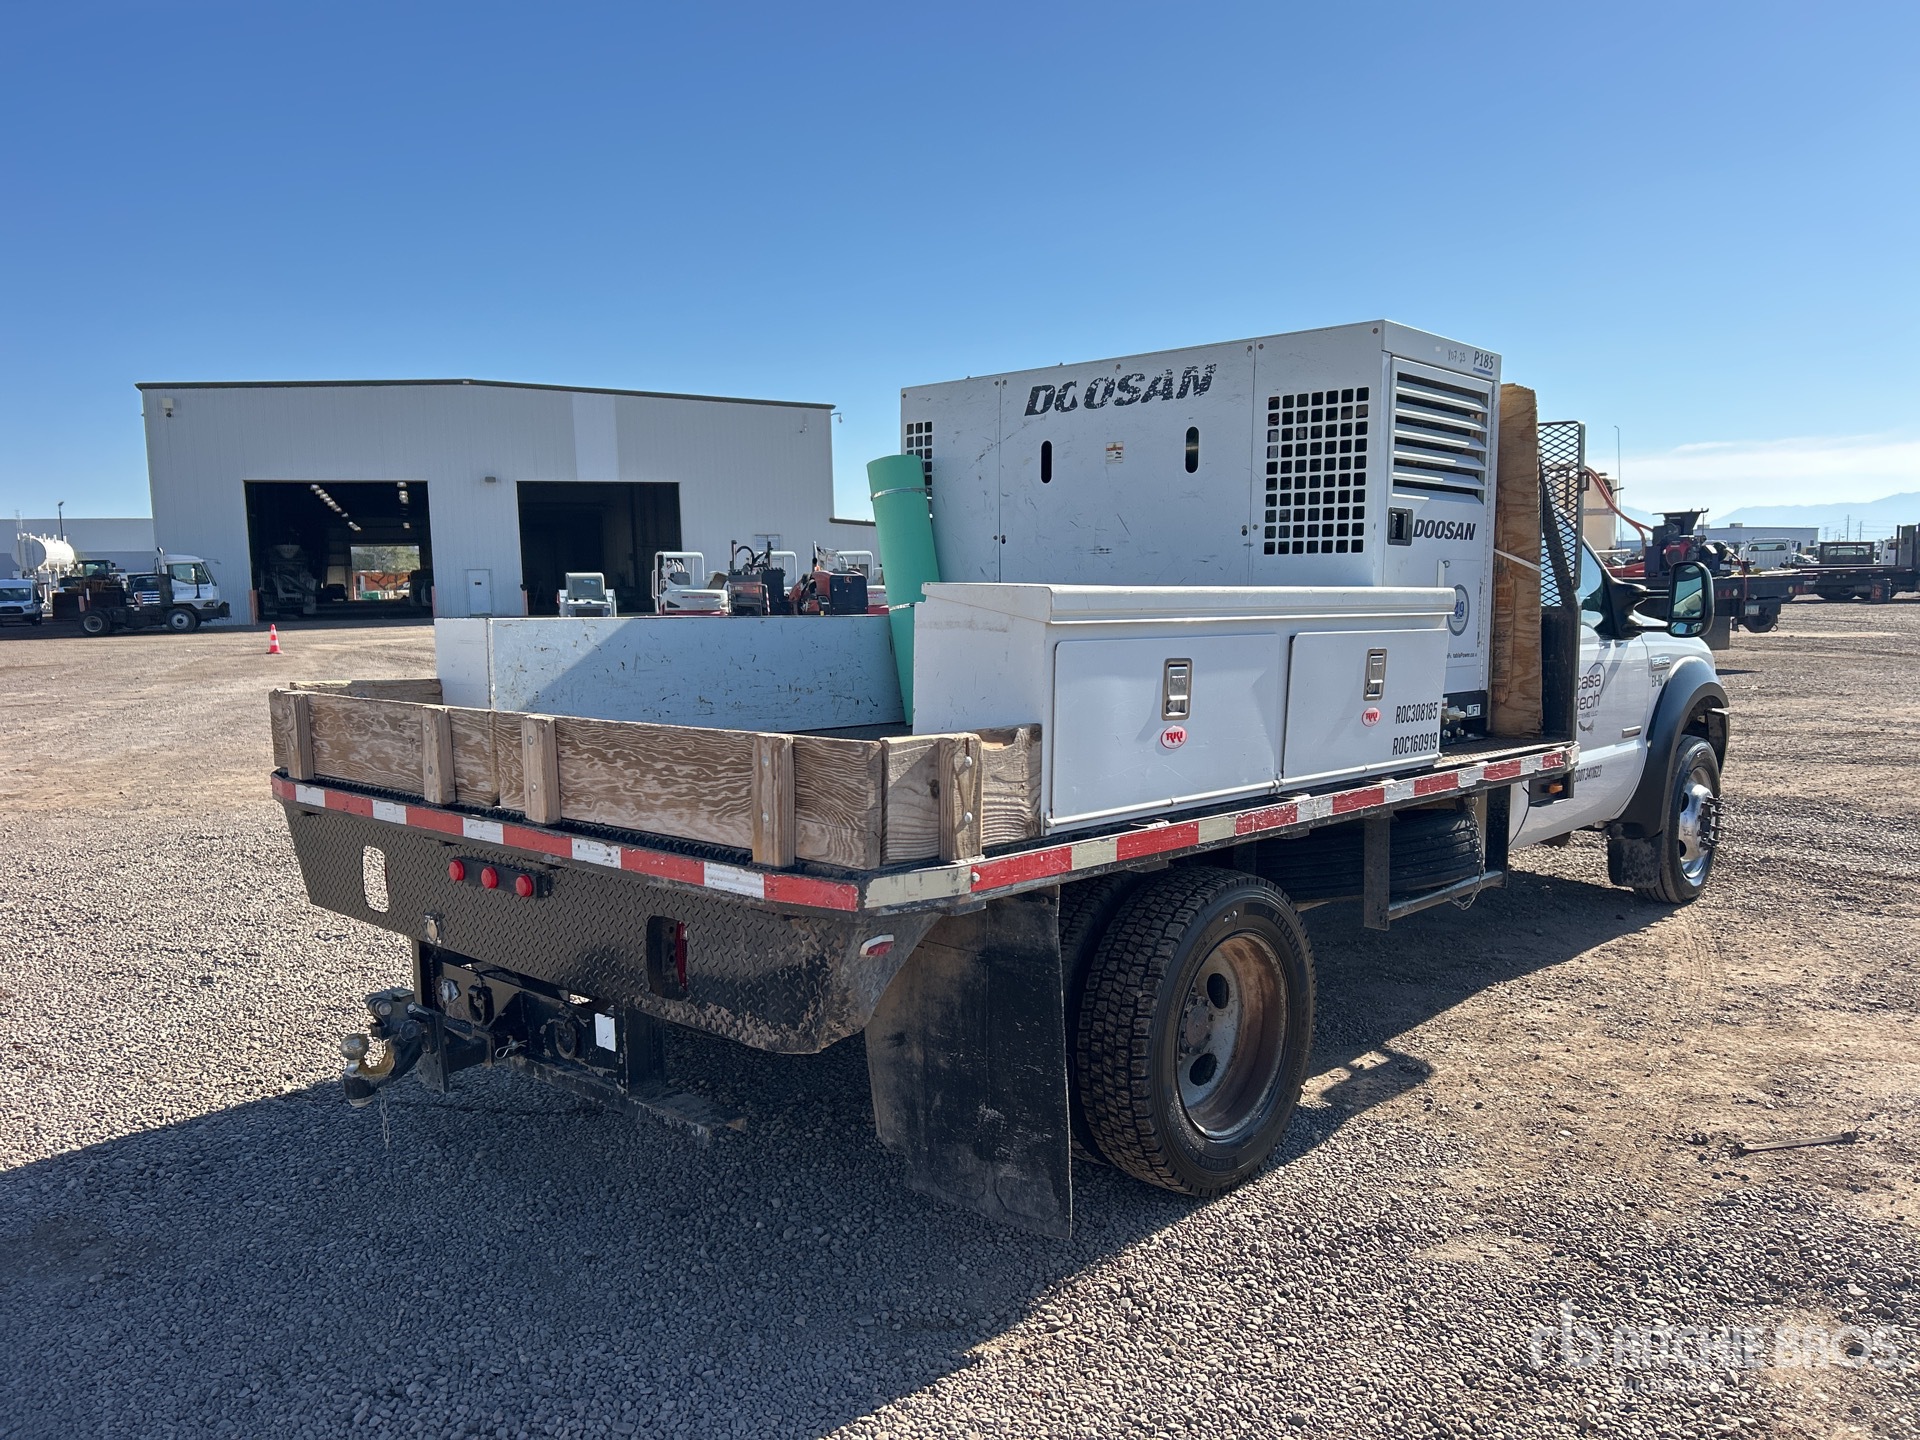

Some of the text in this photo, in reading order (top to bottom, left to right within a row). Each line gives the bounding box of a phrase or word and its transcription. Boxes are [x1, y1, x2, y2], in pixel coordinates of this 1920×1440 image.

[1473, 350, 1494, 370] P185
[1024, 363, 1217, 416] DOOSAN
[1412, 519, 1476, 540] DOOSAN
[1365, 711, 1378, 722] RKI
[1395, 702, 1438, 724] ROC308185
[1467, 704, 1480, 716] LIFT
[1165, 731, 1183, 743] RKI
[1392, 732, 1438, 755] ROC160919
